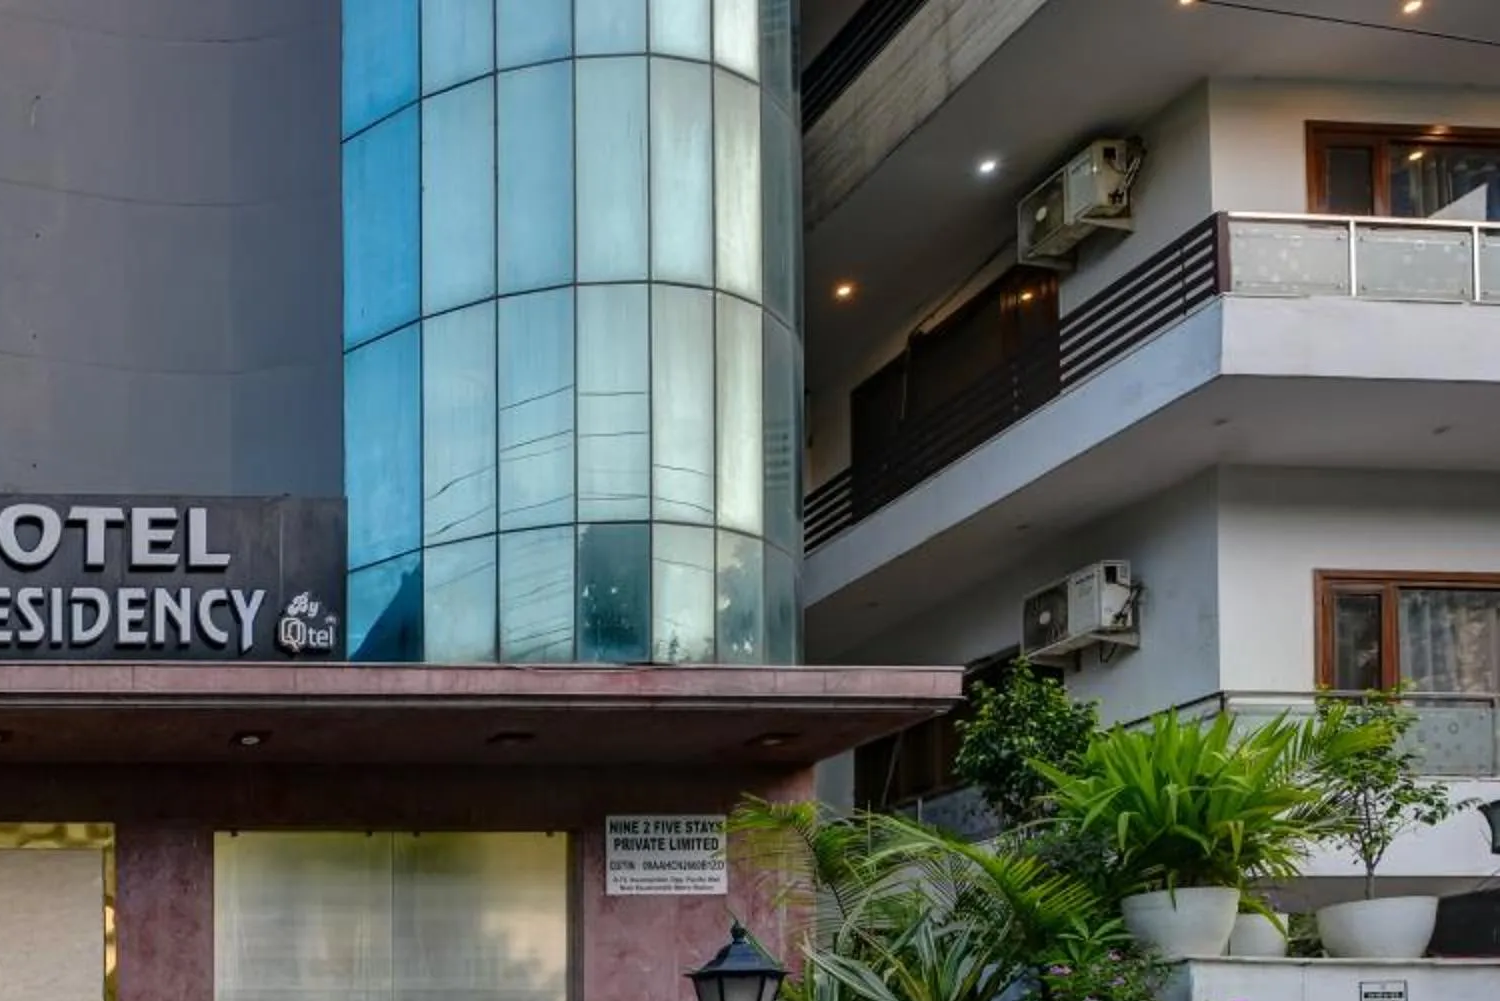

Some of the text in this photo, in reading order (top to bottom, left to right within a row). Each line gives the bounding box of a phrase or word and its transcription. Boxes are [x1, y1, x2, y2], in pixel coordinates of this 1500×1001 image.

[609, 821, 639, 834] NINE
[643, 821, 651, 834] 2
[654, 821, 681, 834] FIVE
[613, 837, 719, 850] PRIVATE LIMITED
